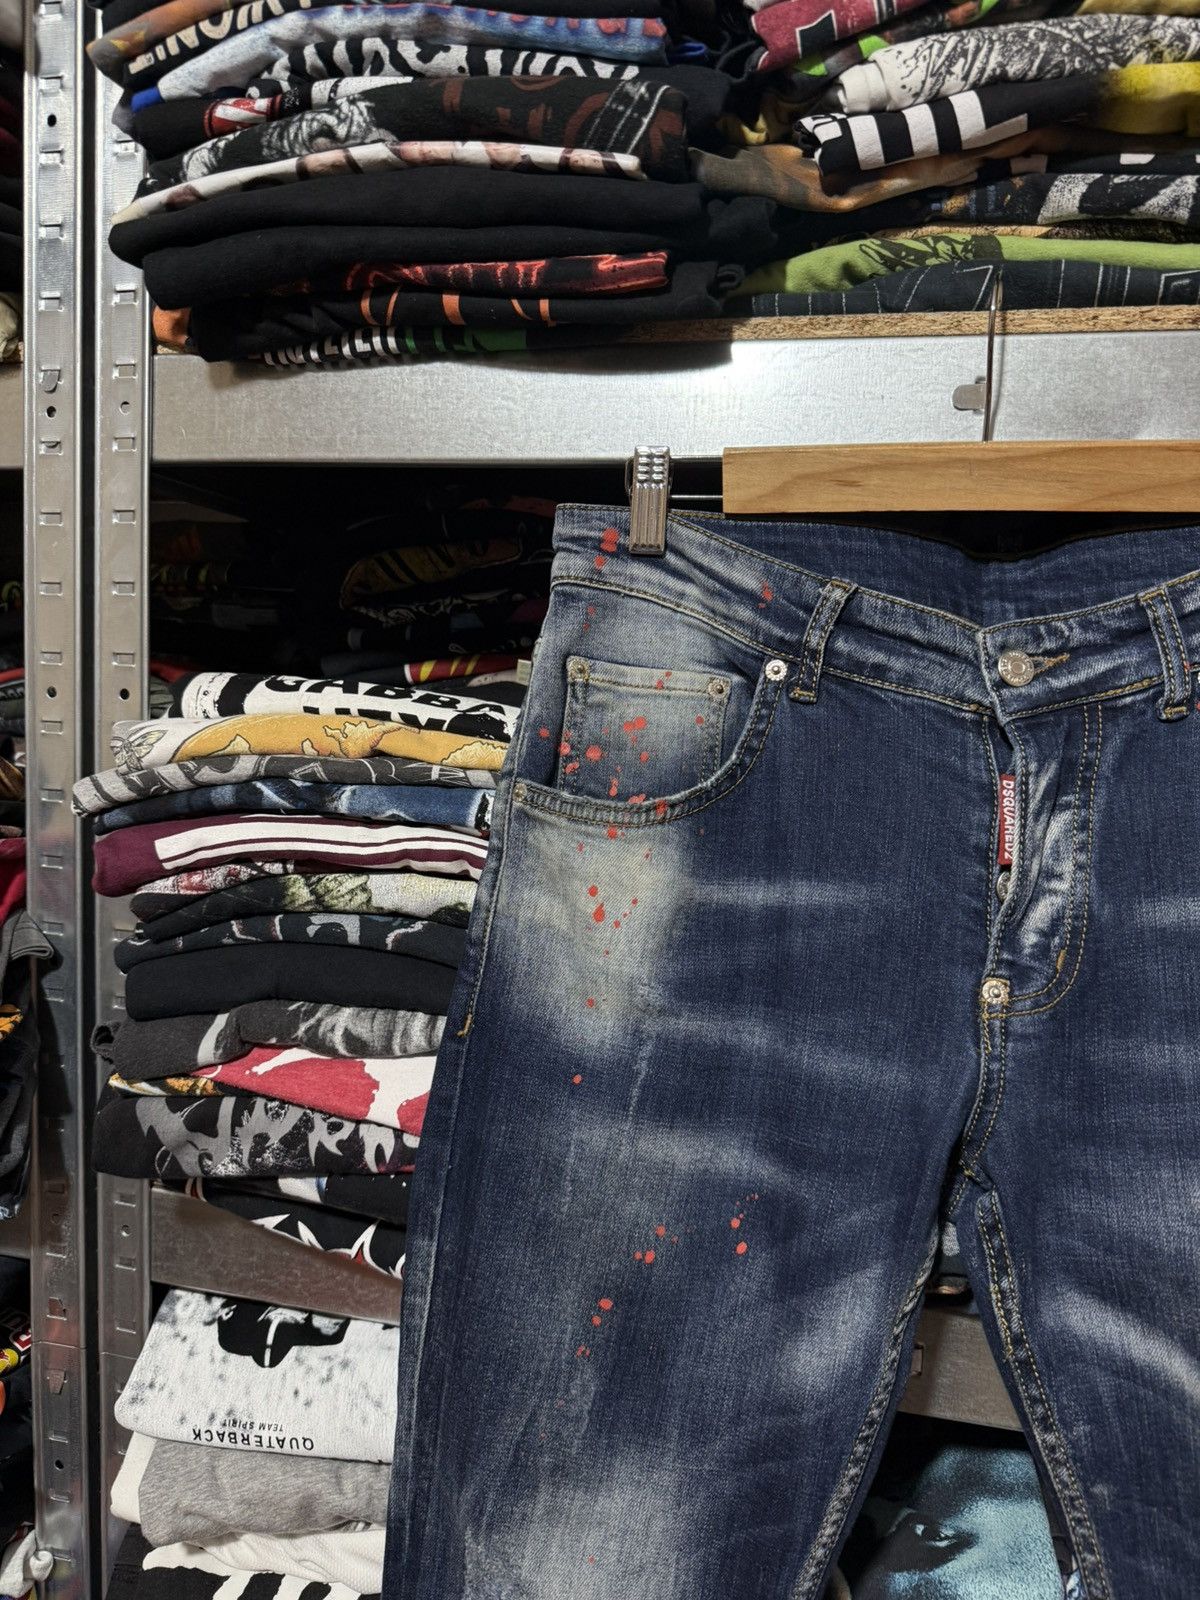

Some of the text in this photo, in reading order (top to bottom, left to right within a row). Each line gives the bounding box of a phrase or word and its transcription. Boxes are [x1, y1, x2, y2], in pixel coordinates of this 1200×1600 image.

[222, 1419, 283, 1432] TEAM SPIRIT
[192, 1428, 314, 1451] QUATERBACK
